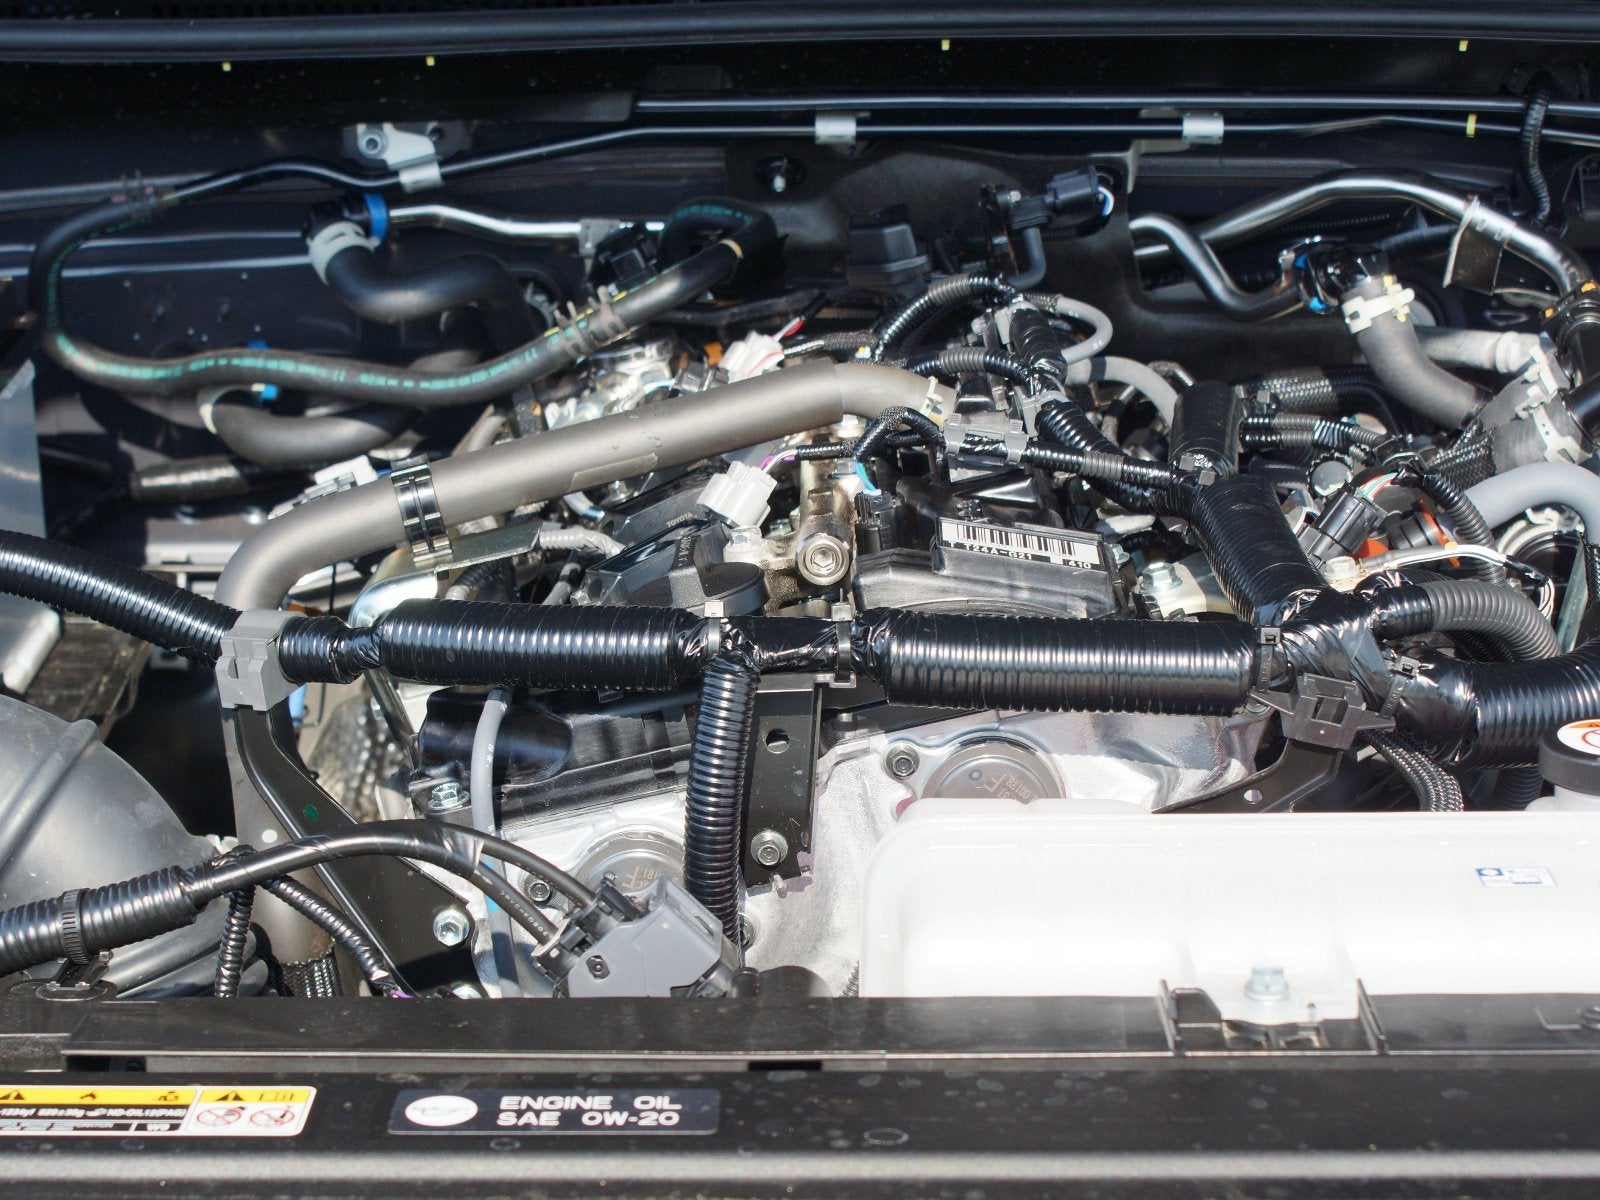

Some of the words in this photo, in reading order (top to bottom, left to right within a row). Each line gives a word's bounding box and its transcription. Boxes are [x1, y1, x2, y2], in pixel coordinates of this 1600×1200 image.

[666, 512, 694, 527] TOYOTA
[963, 542, 1033, 560] T24A-G21
[1068, 560, 1092, 569] 410
[499, 1095, 613, 1110] ENGINE
[633, 1095, 682, 1110] OIL
[496, 1111, 561, 1126] SAE
[581, 1111, 680, 1126] 0W-20
